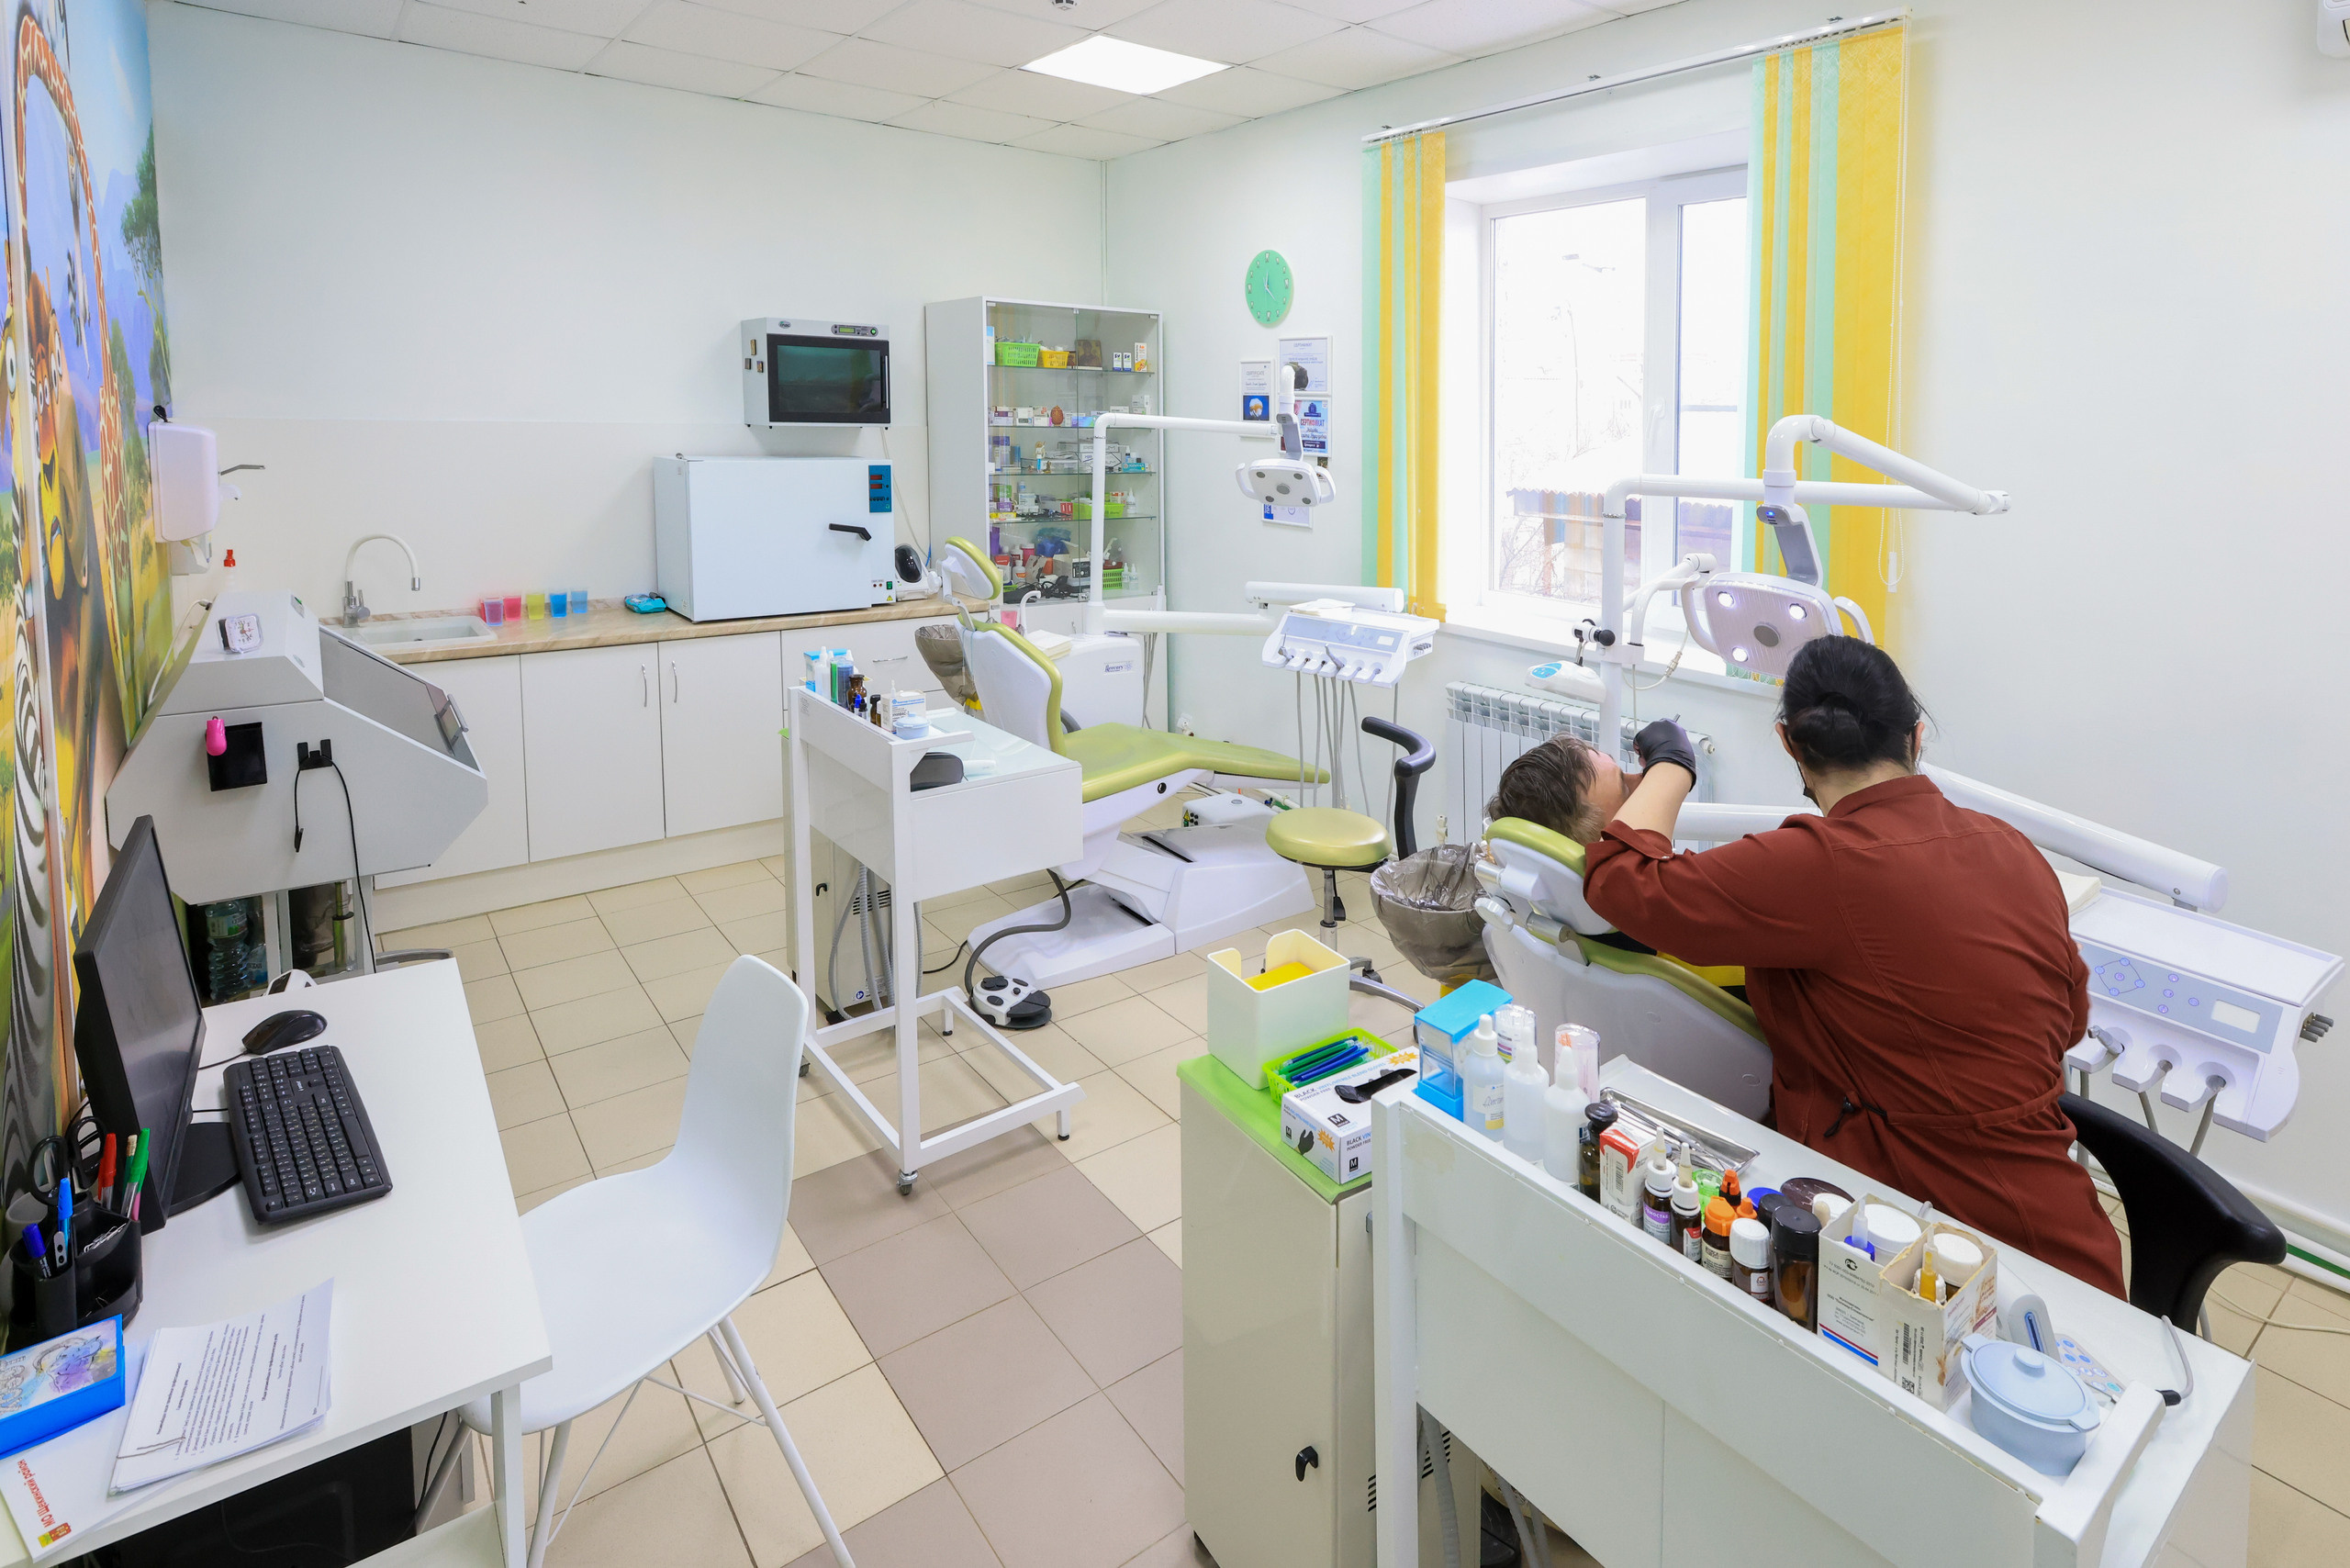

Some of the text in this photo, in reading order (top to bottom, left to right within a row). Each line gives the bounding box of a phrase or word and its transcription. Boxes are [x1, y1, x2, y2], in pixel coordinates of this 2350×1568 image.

[1294, 1088, 1316, 1099] BLACK
[1346, 1136, 1362, 1146] BLACK
[1346, 1141, 1362, 1152] POWDER
[17, 1459, 55, 1528] МО Щекинский район
